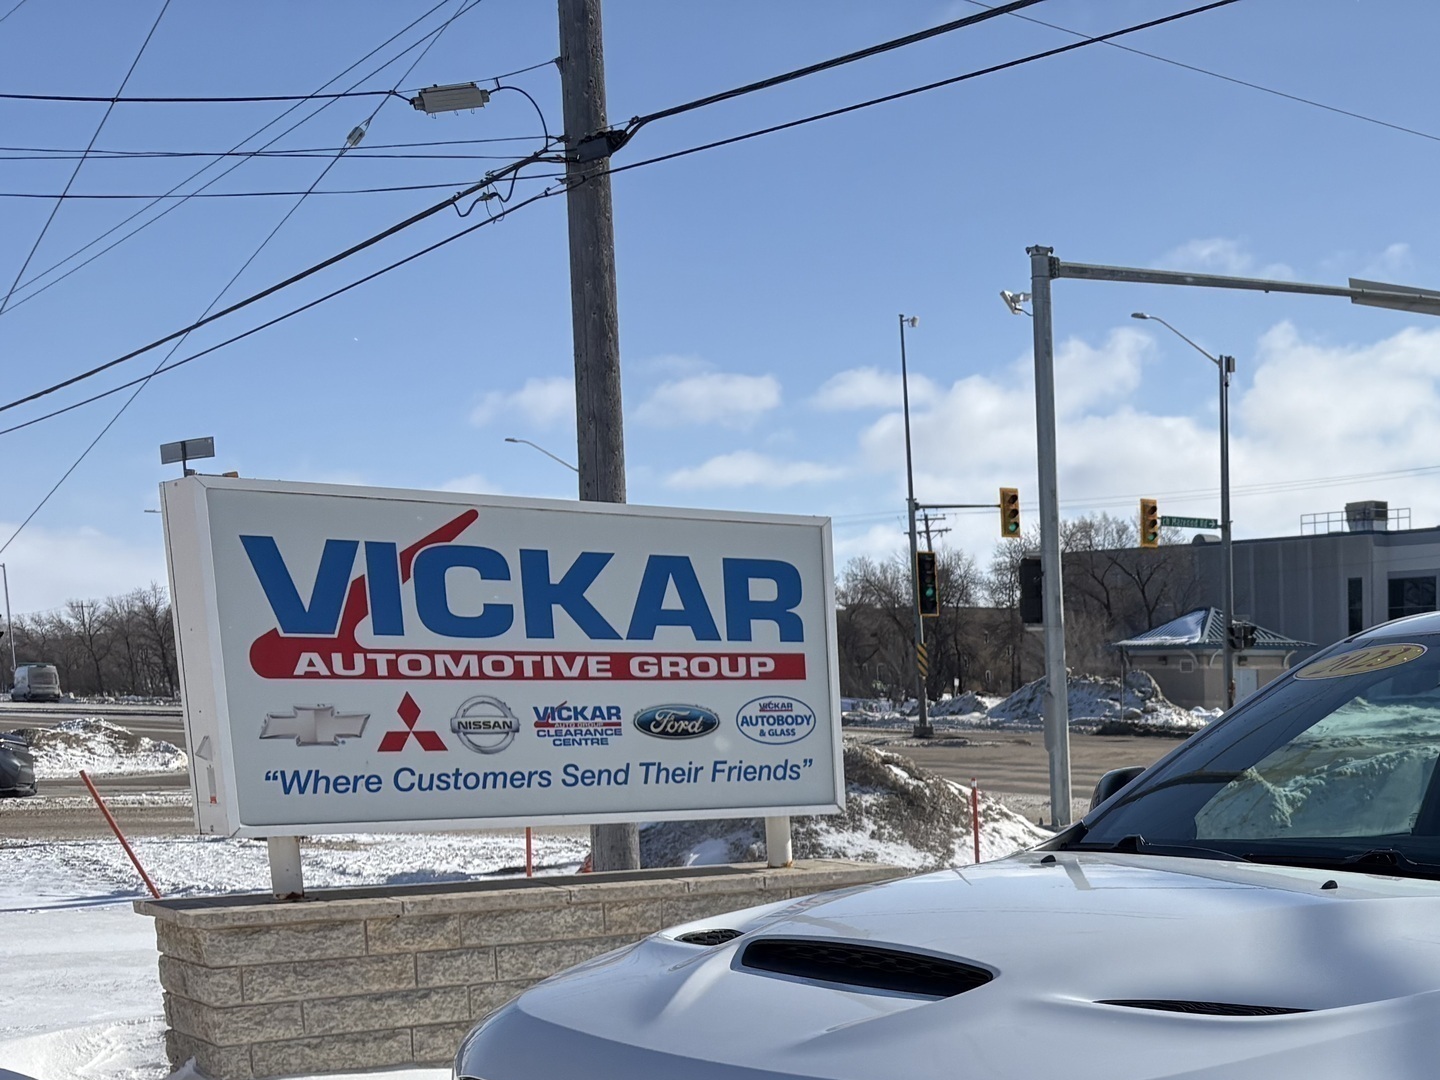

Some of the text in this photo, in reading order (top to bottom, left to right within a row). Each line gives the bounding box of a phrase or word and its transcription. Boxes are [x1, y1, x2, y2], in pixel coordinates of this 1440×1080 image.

[238, 533, 805, 643] VICKAR
[293, 651, 776, 679] AUTOMOTIVE GROUP
[1304, 645, 1414, 676] 2023
[532, 704, 623, 722] VICKAR
[758, 702, 794, 712] VICKAR
[457, 720, 513, 730] NISSAN
[650, 709, 704, 735] Ford
[740, 714, 812, 727] AUTOBODY
[536, 728, 623, 738] CLEARANCE
[759, 728, 796, 737] & GLASS
[552, 737, 609, 747] CENTRE
[392, 766, 552, 793] Customers
[561, 762, 630, 788] Send
[639, 761, 704, 784] Their
